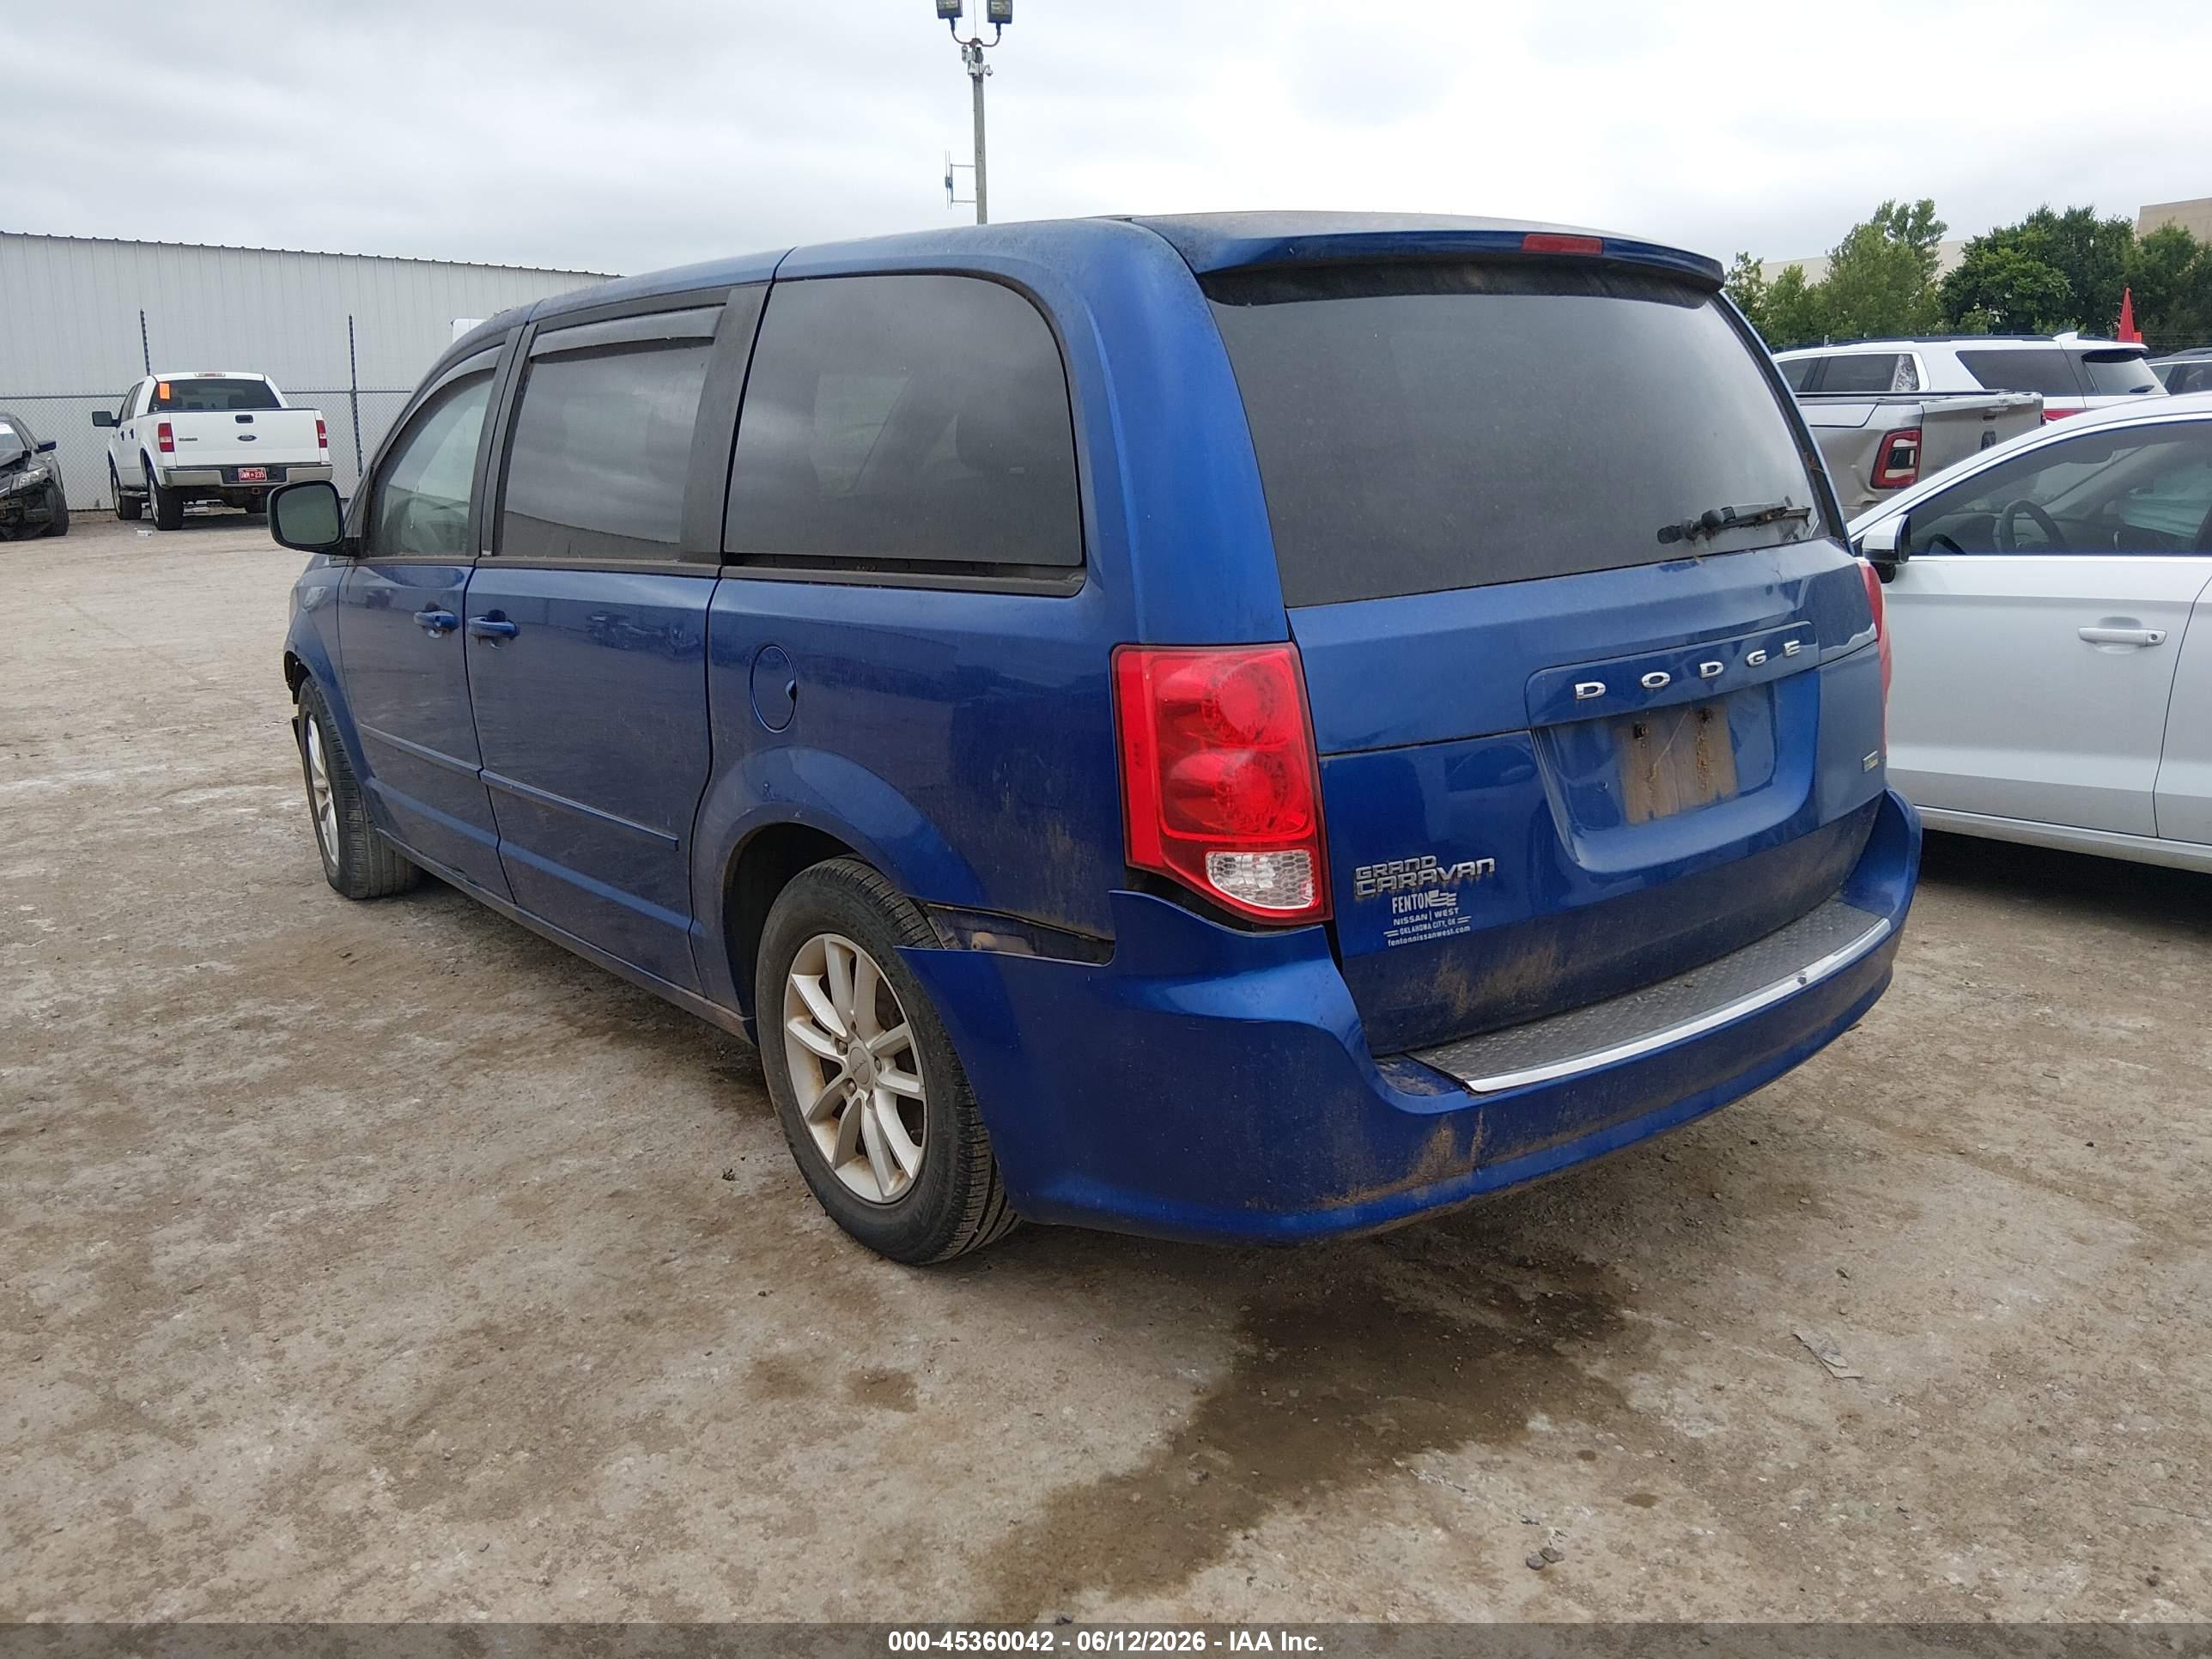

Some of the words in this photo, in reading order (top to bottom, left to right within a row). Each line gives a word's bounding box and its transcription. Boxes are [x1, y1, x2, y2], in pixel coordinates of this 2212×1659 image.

[1574, 639, 1801, 701] DODGE
[1355, 854, 1437, 880] GRAND
[1355, 857, 1496, 896] CARAVAN
[1391, 891, 1432, 915] FENTON
[1393, 913, 1429, 927] NISSAN
[1434, 907, 1460, 918] WEST
[1388, 925, 1471, 948] fentonnissanwest.com
[1399, 923, 1432, 936] OKLAHOMA
